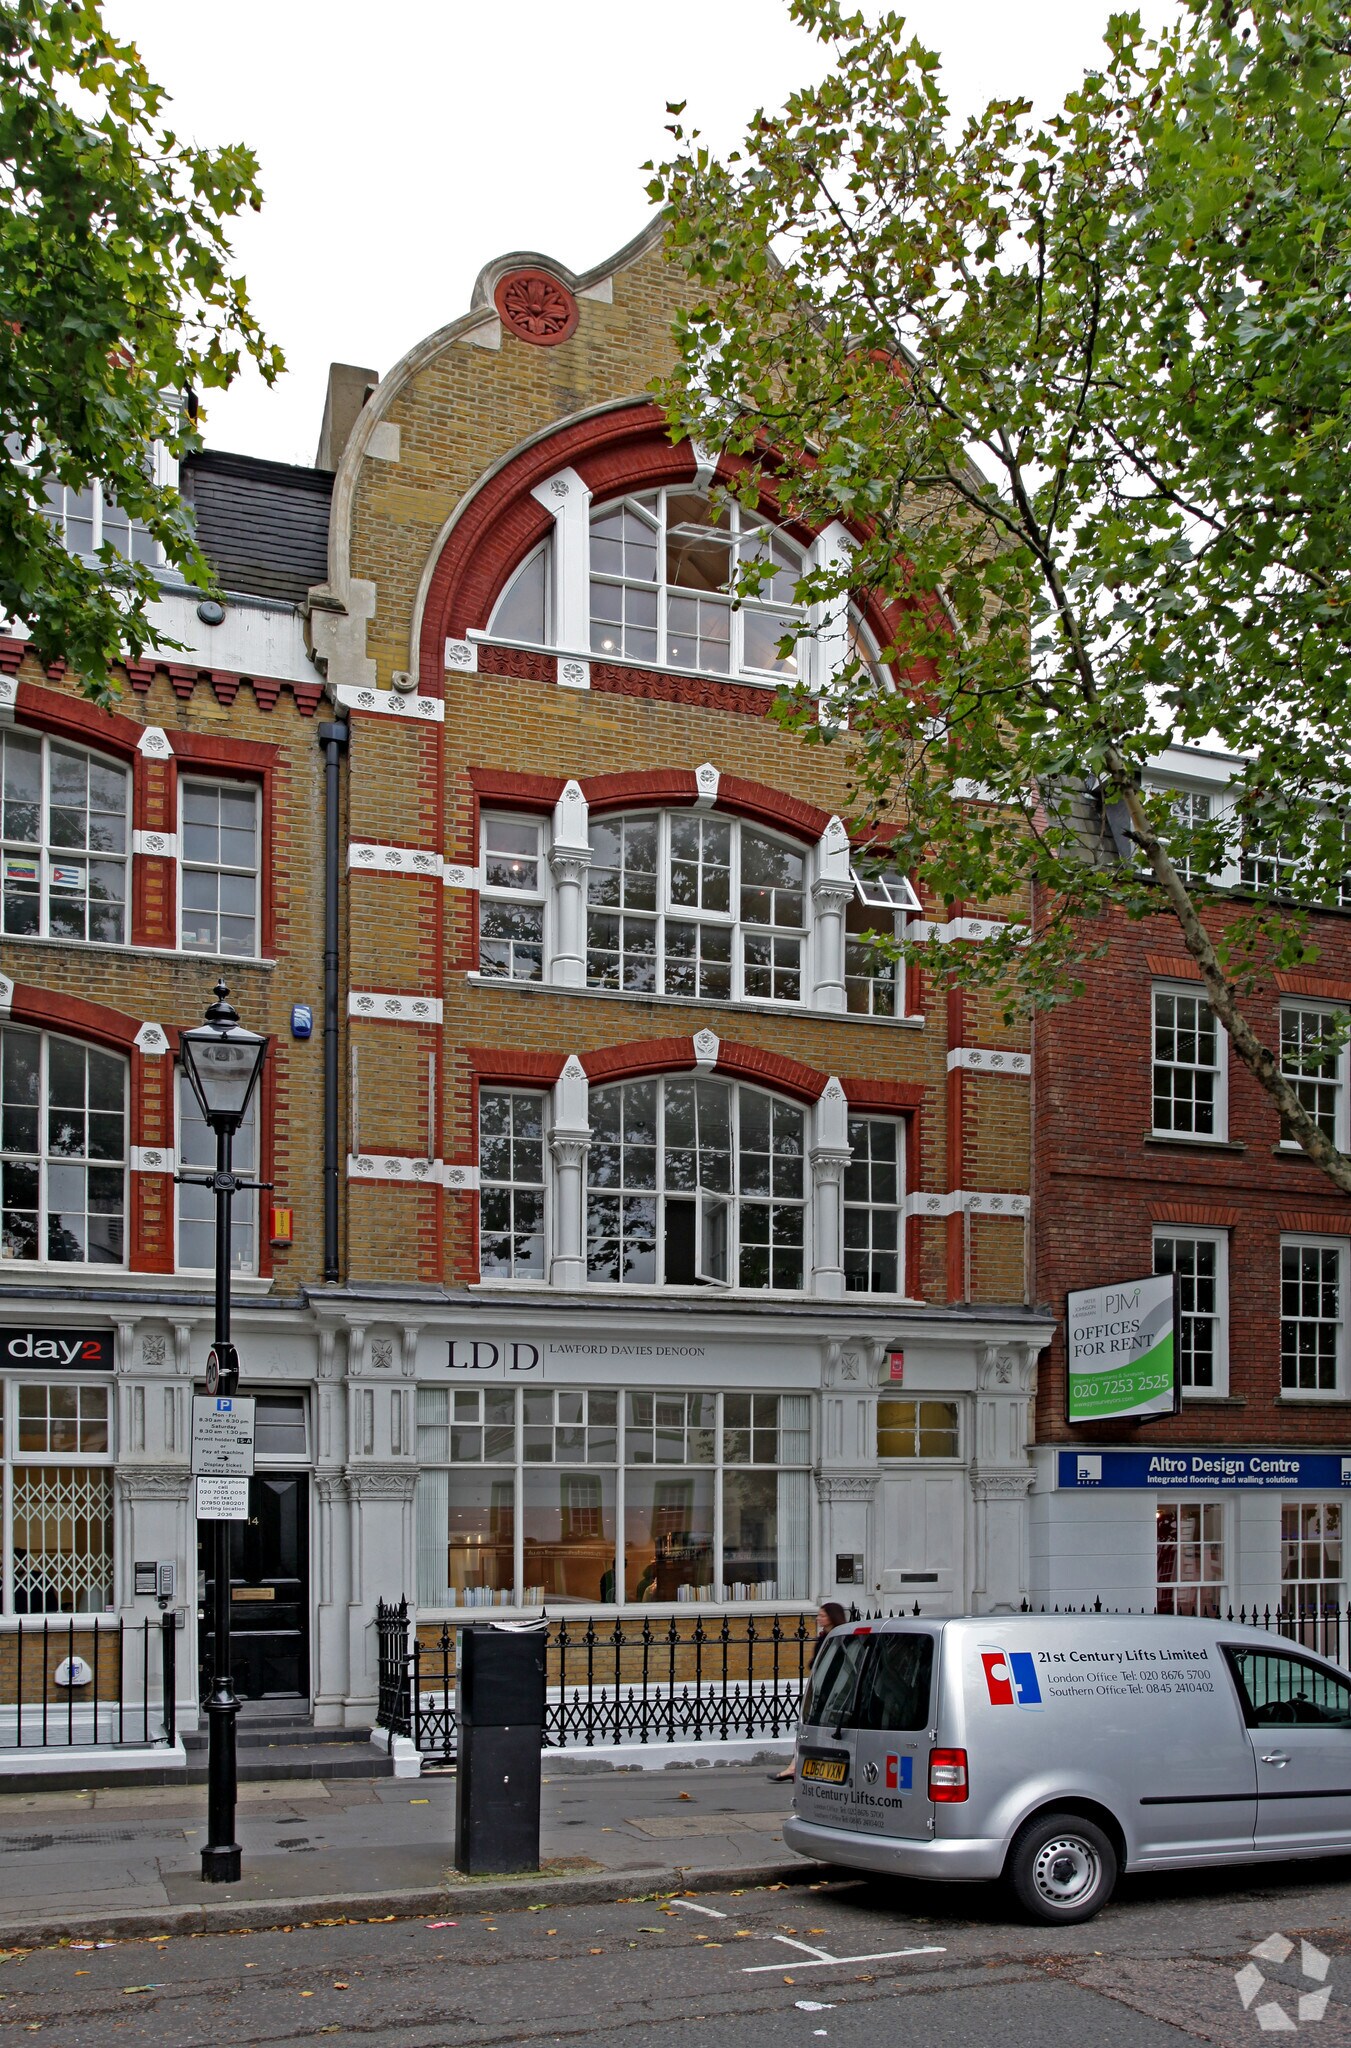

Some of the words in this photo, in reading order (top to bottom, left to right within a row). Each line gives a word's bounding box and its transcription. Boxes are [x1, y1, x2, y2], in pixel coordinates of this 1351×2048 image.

[1074, 1319, 1140, 1341] OFFICES
[8, 1334, 102, 1364] day2
[549, 1344, 607, 1354] LAWFORD
[611, 1345, 652, 1355] DAVIES
[656, 1346, 705, 1356] DENOON
[1074, 1341, 1106, 1358] FOR
[1110, 1333, 1154, 1352] RENT
[1073, 1383, 1099, 1398] 020
[1103, 1379, 1133, 1395] 7253
[1138, 1374, 1169, 1391] 2525
[1149, 1456, 1187, 1472] Altro
[1192, 1457, 1245, 1475] Design
[1249, 1457, 1300, 1473] Centre
[1147, 1475, 1188, 1485] Integrated
[1189, 1475, 1220, 1485] flooring
[1221, 1475, 1237, 1484] and
[1237, 1475, 1264, 1485] walling
[1265, 1475, 1299, 1484] solutions
[248, 1516, 259, 1525] 14
[1037, 1651, 1066, 1663] 21st
[1069, 1650, 1123, 1664] Century
[1125, 1649, 1157, 1662] Lifts
[1160, 1648, 1209, 1661] Limited
[1047, 1672, 1084, 1683] London
[1087, 1672, 1118, 1683] Office
[1120, 1670, 1137, 1681] Tel:
[1139, 1671, 1159, 1681] 020
[1161, 1670, 1184, 1681] 8676
[1187, 1670, 1211, 1680] 5700
[1049, 1686, 1094, 1697] Southern
[1096, 1685, 1127, 1696] Office
[1127, 1684, 1144, 1695] Tel:
[1146, 1684, 1172, 1694] 0845
[1175, 1682, 1215, 1693] 2410402
[805, 1760, 824, 1776] LD60
[826, 1763, 843, 1780] VXN
[802, 1783, 814, 1797] 21st
[815, 1786, 849, 1805] Century
[850, 1791, 903, 1808] Lifts.com
